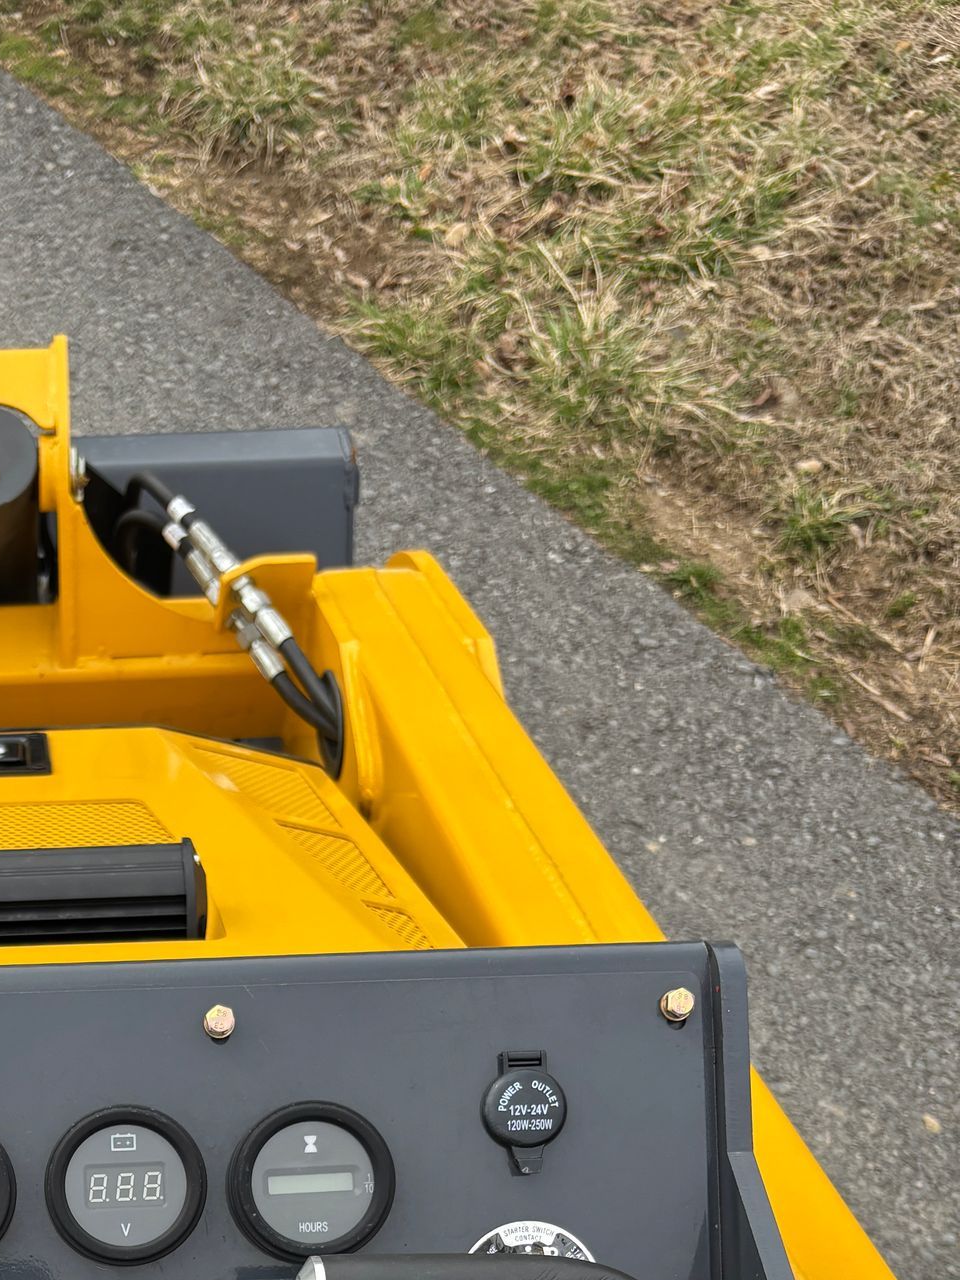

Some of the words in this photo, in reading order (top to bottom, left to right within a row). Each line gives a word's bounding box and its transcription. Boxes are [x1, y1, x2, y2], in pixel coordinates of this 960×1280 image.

[498, 1081, 523, 1112] POWER
[531, 1080, 559, 1108] OUTLET
[509, 1104, 548, 1116] 12V-24V
[507, 1119, 553, 1131] 120W-250W
[121, 1222, 131, 1237] V
[298, 1221, 329, 1233] HOURS
[503, 1225, 529, 1238] STARTER
[531, 1225, 555, 1237] SWITCH
[514, 1234, 542, 1243] CONTACT
